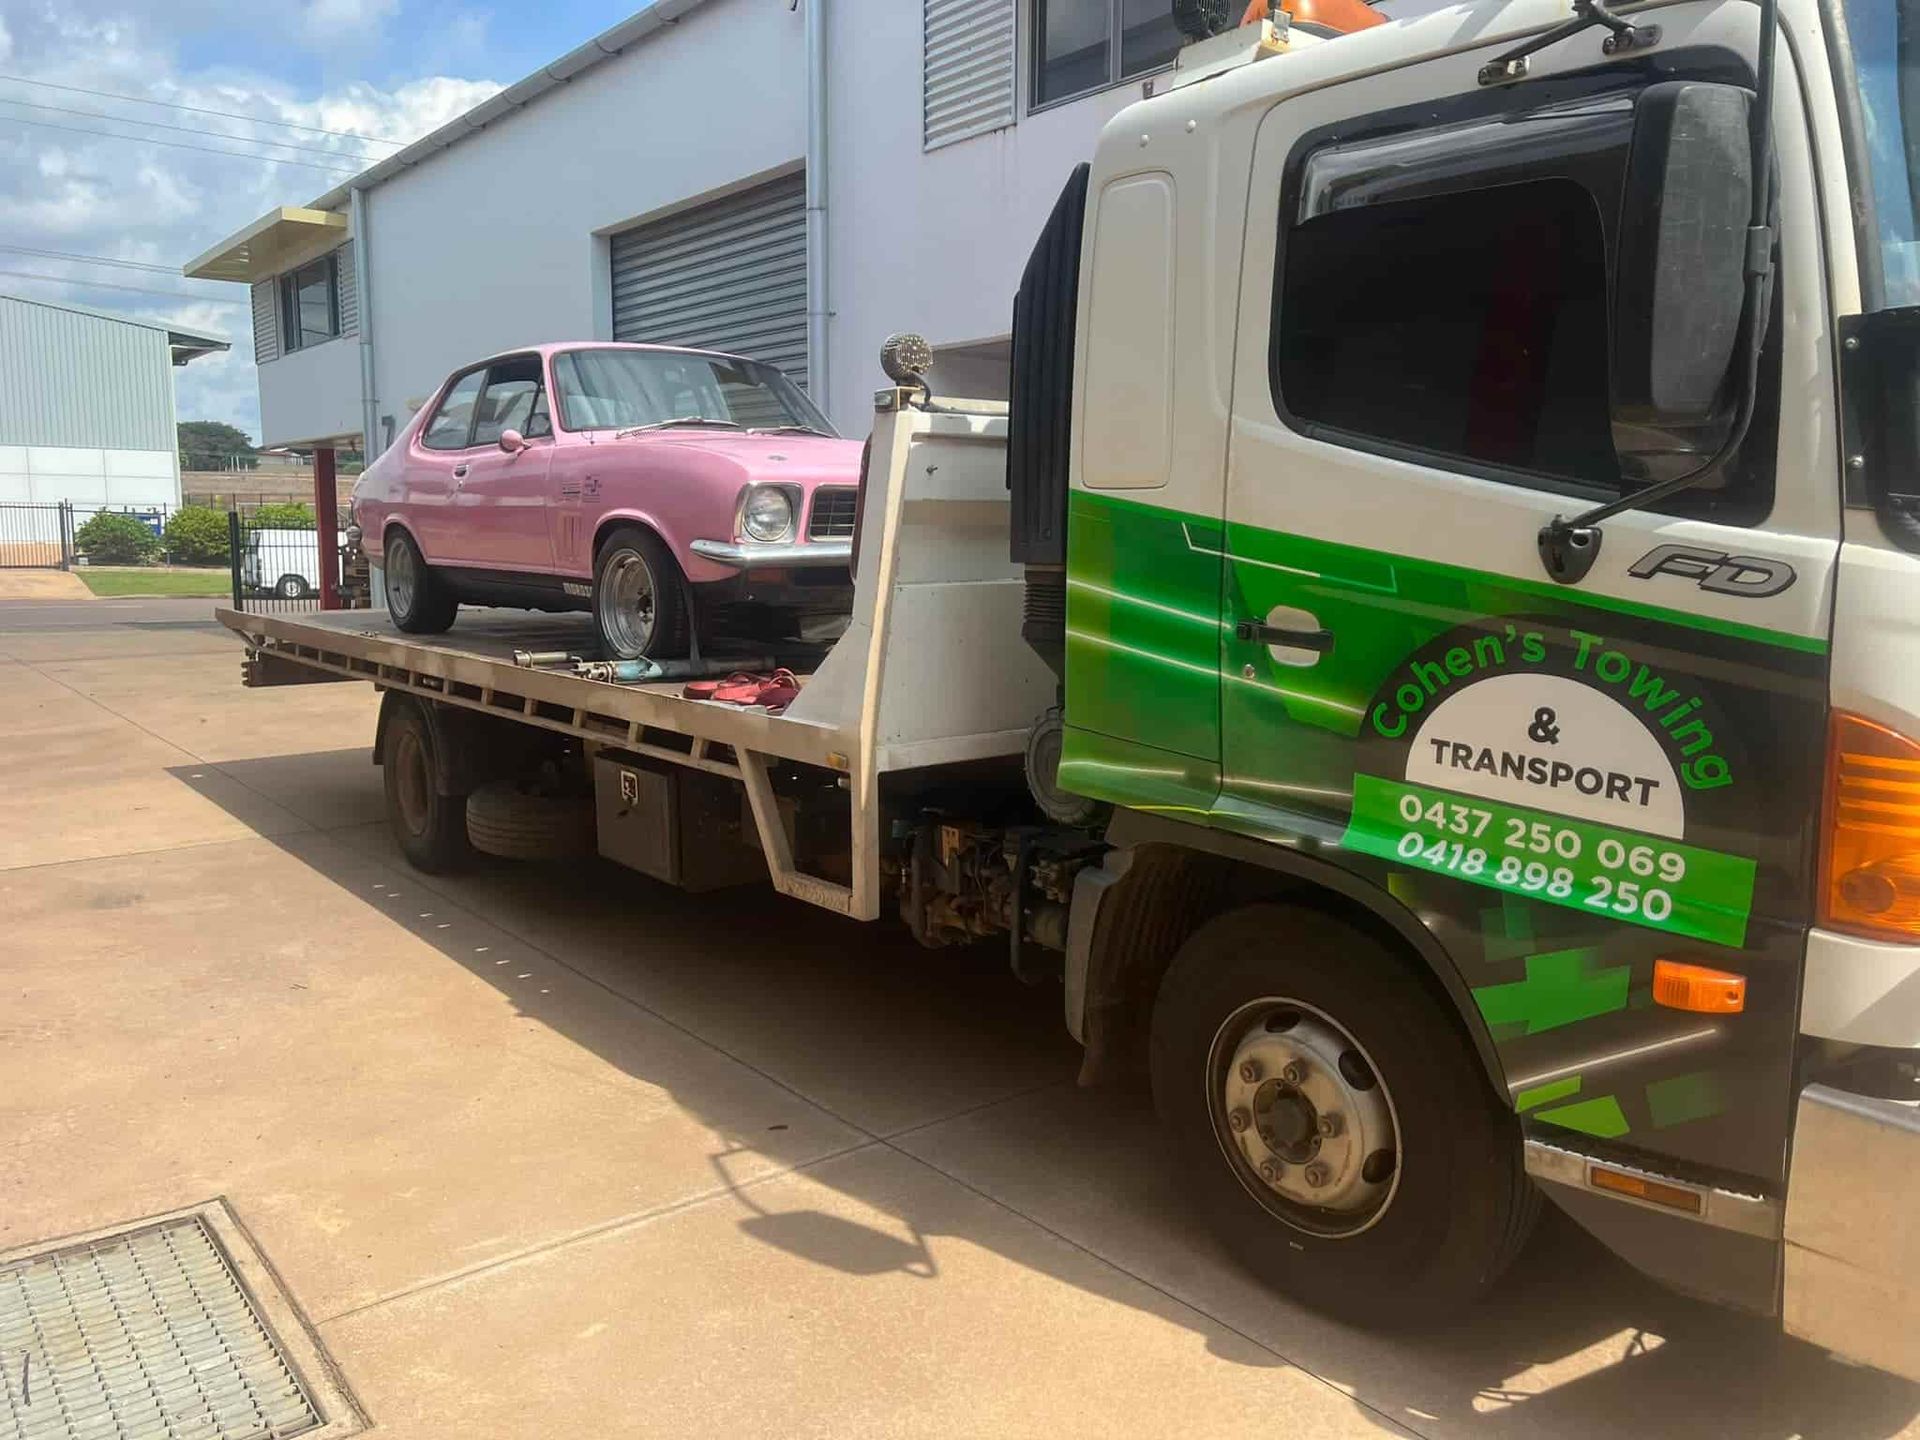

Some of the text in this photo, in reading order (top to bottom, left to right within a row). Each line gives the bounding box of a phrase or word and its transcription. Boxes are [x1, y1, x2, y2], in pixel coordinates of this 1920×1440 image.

[1627, 544, 1797, 598] FD
[1372, 624, 1733, 790] Cohen's Towing
[1527, 706, 1560, 745] &
[1430, 738, 1660, 807] TRANSPORT
[1397, 832, 1673, 921] 0418 898 250
[1399, 794, 1686, 882] 0437 250 069
